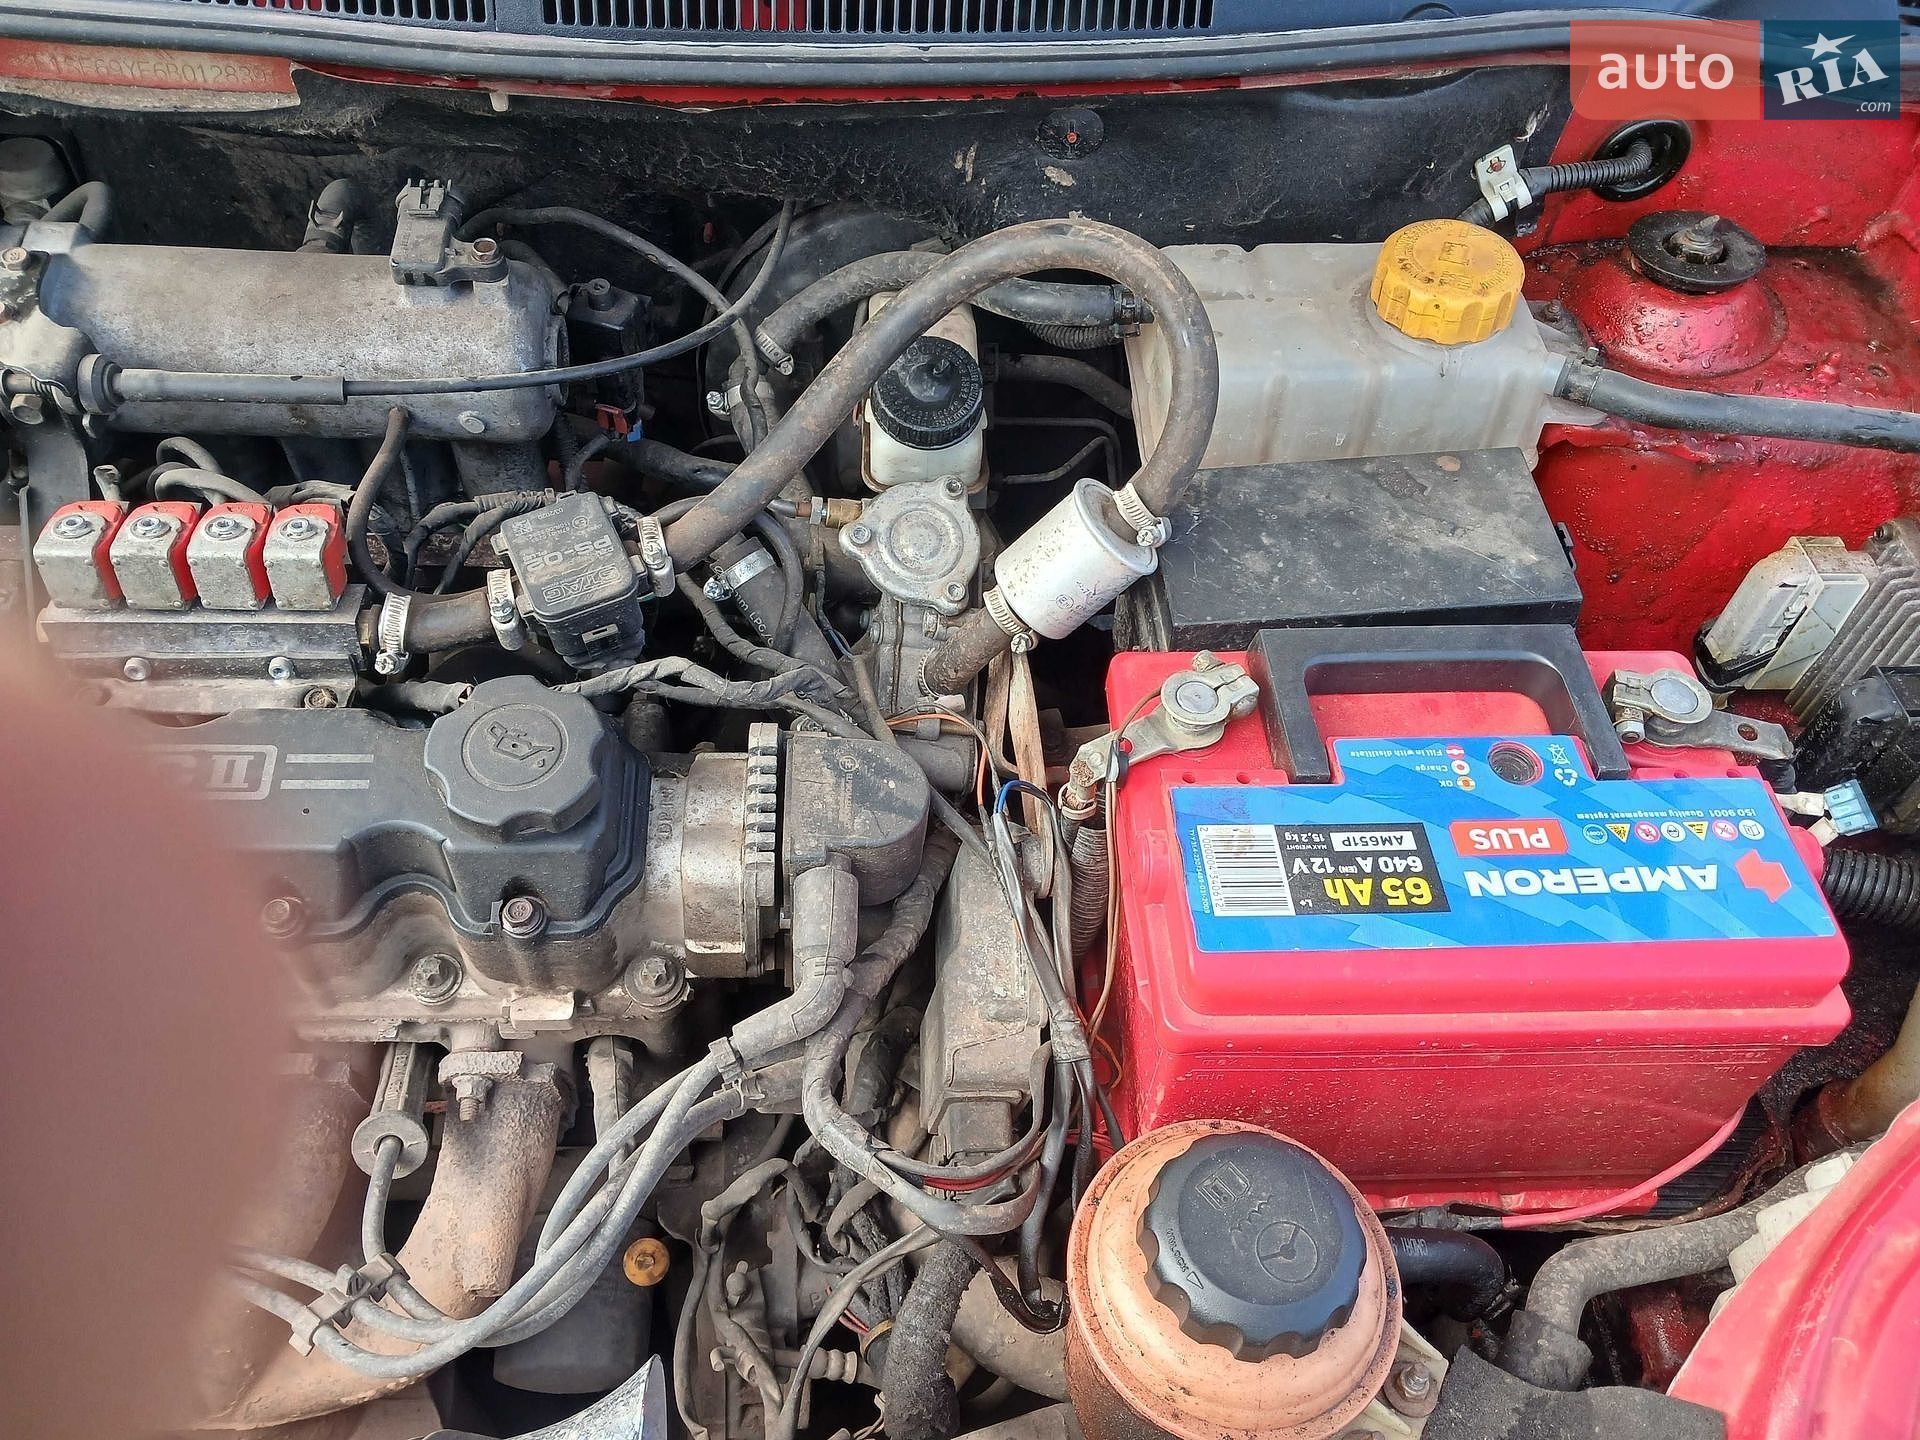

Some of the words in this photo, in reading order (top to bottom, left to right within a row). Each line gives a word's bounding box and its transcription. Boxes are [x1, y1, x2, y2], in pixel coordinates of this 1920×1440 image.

[542, 566, 621, 602] STAG
[1394, 749, 1414, 759] with
[1415, 764, 1448, 772] Charge
[1439, 780, 1454, 788] OK
[1576, 811, 1608, 820] system
[1610, 809, 1667, 819] management
[1668, 808, 1704, 818] Quality
[1709, 809, 1736, 818] 9001
[1737, 808, 1756, 817] ISO
[1284, 831, 1300, 842] kg
[1301, 832, 1325, 842] 15,2
[1342, 835, 1404, 847] AM651P
[1468, 828, 1551, 850] PLUS
[1291, 857, 1307, 874] V
[1310, 858, 1335, 873] 12
[1378, 856, 1424, 873] 640
[1463, 864, 1718, 897] AMPERON
[1323, 877, 1374, 906] Ah
[1380, 876, 1433, 906] 65
